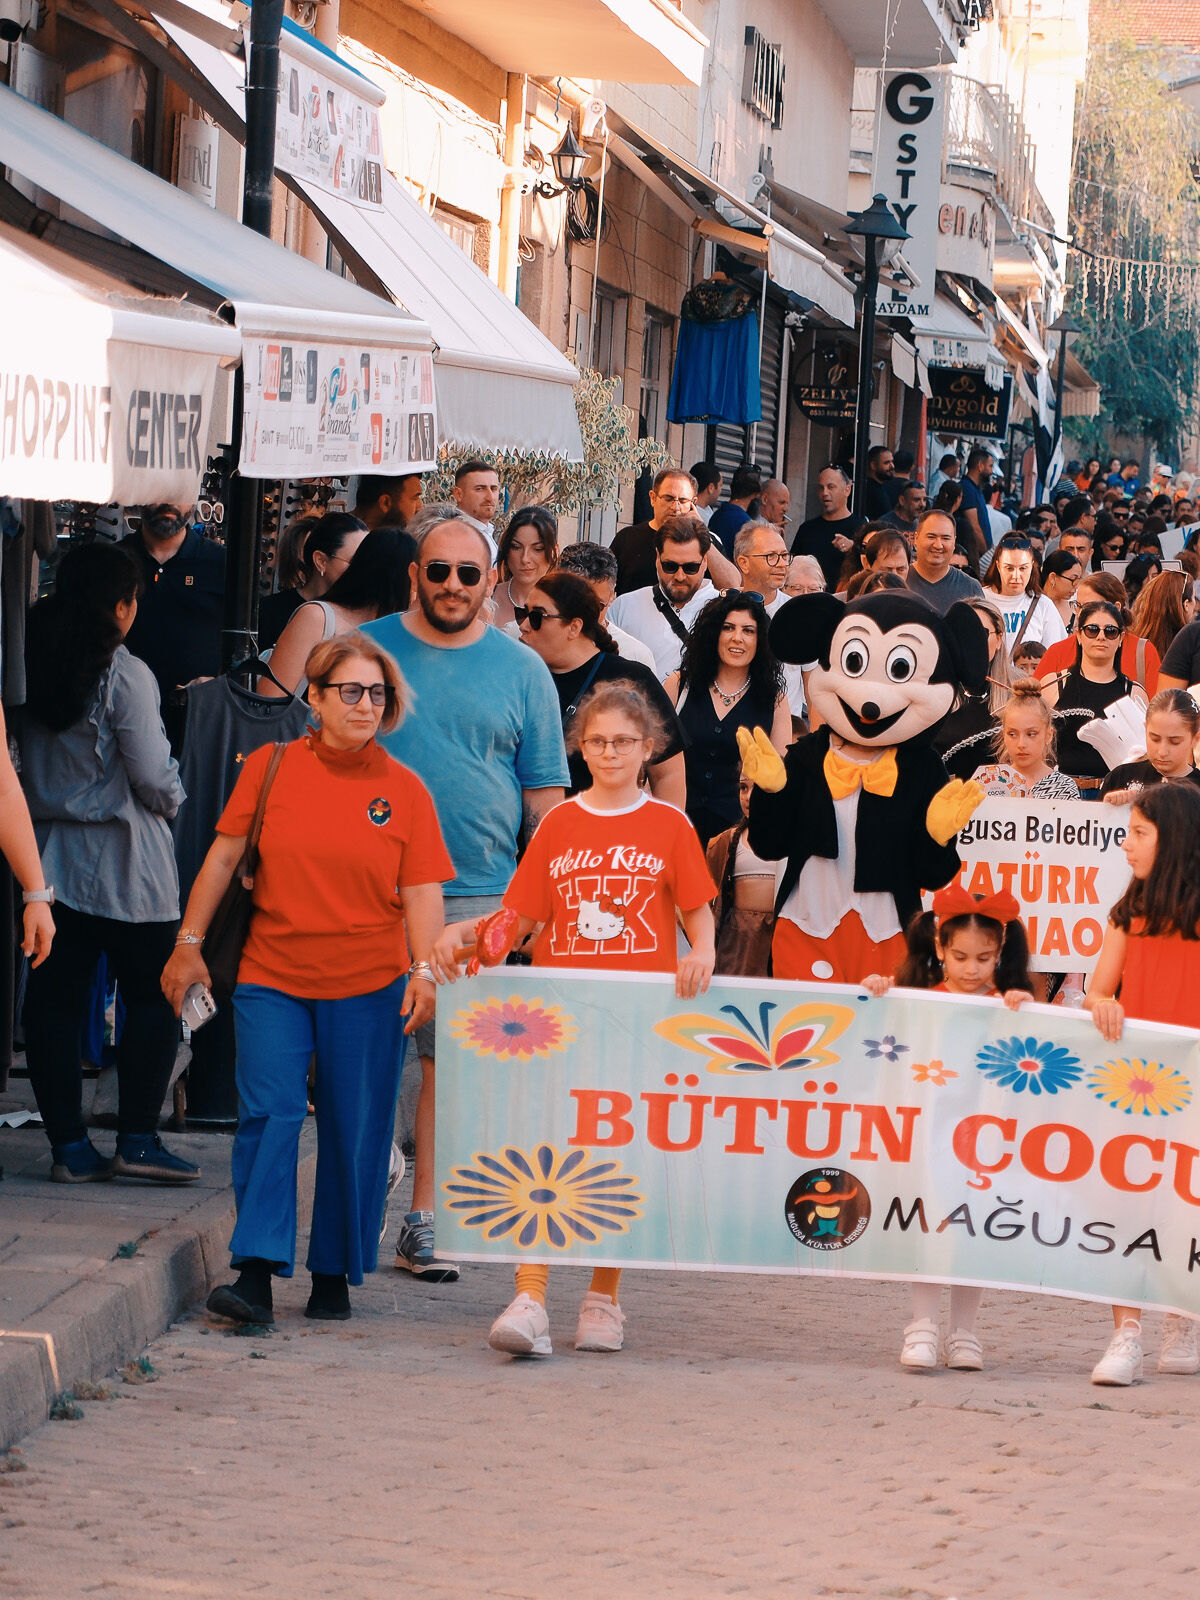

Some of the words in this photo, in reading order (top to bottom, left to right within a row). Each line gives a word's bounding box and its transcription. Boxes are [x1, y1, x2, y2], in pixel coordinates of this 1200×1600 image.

[891, 133, 918, 303] STYE
[938, 203, 967, 236] en
[0, 371, 112, 464] HOPPING
[126, 389, 202, 478] CENTER
[927, 416, 998, 433] uyumculuk
[548, 848, 603, 879] Hello
[606, 846, 666, 876] Kitty
[945, 850, 1100, 905] TATÜRK
[568, 1072, 922, 1163] BÜTÜN
[821, 1169, 840, 1177] 1999
[787, 1212, 806, 1242] MAĞUSA
[805, 1238, 843, 1250] KÜLTÜR
[883, 1195, 1163, 1263] MAĞUSA
